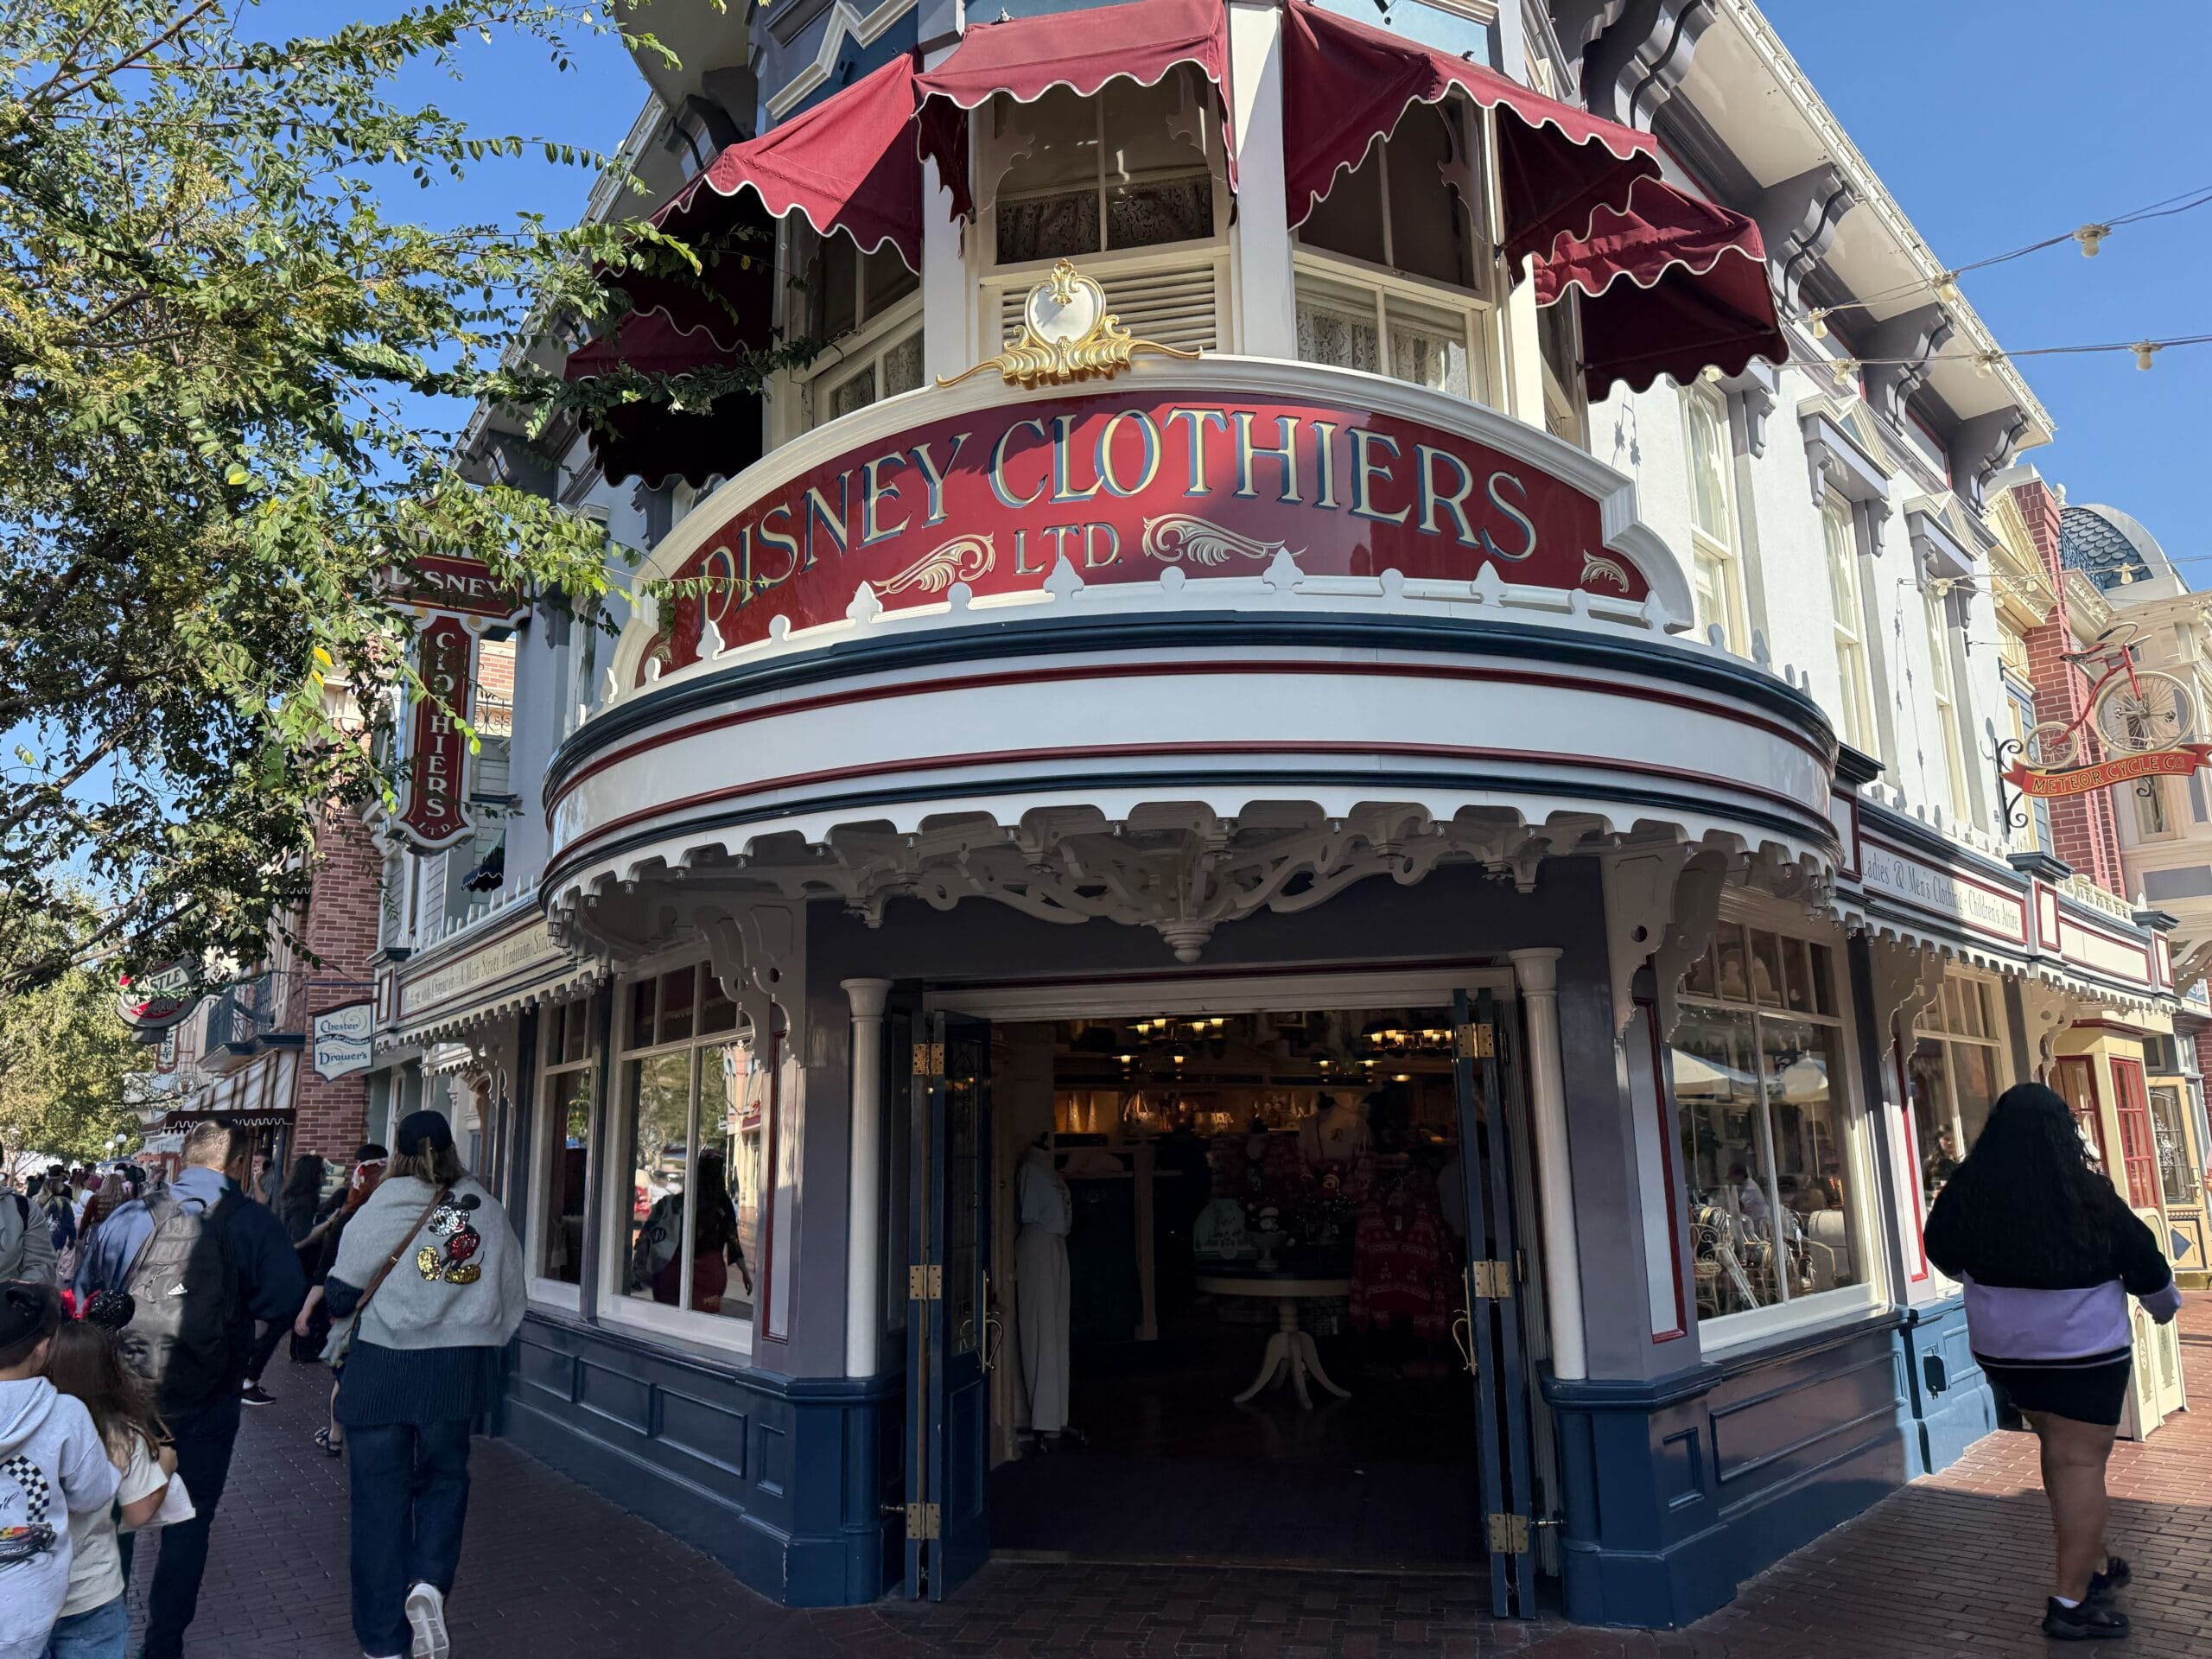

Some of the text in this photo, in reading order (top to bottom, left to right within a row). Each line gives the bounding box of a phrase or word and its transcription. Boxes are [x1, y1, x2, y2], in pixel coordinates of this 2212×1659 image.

[698, 407, 1536, 641] DISNEY CLOTHIERS
[1013, 521, 1123, 576] LTD.
[2032, 772, 2104, 793] METEOR
[2107, 755, 2160, 779] CYCLE
[1908, 865, 1931, 899] Men's
[1933, 875, 1964, 916] Clothing
[1968, 889, 2000, 925] Children's
[2001, 901, 2018, 930] Attire
[481, 954, 499, 977] Street
[321, 1020, 359, 1033] Chester
[319, 1051, 367, 1065] Drawer's
